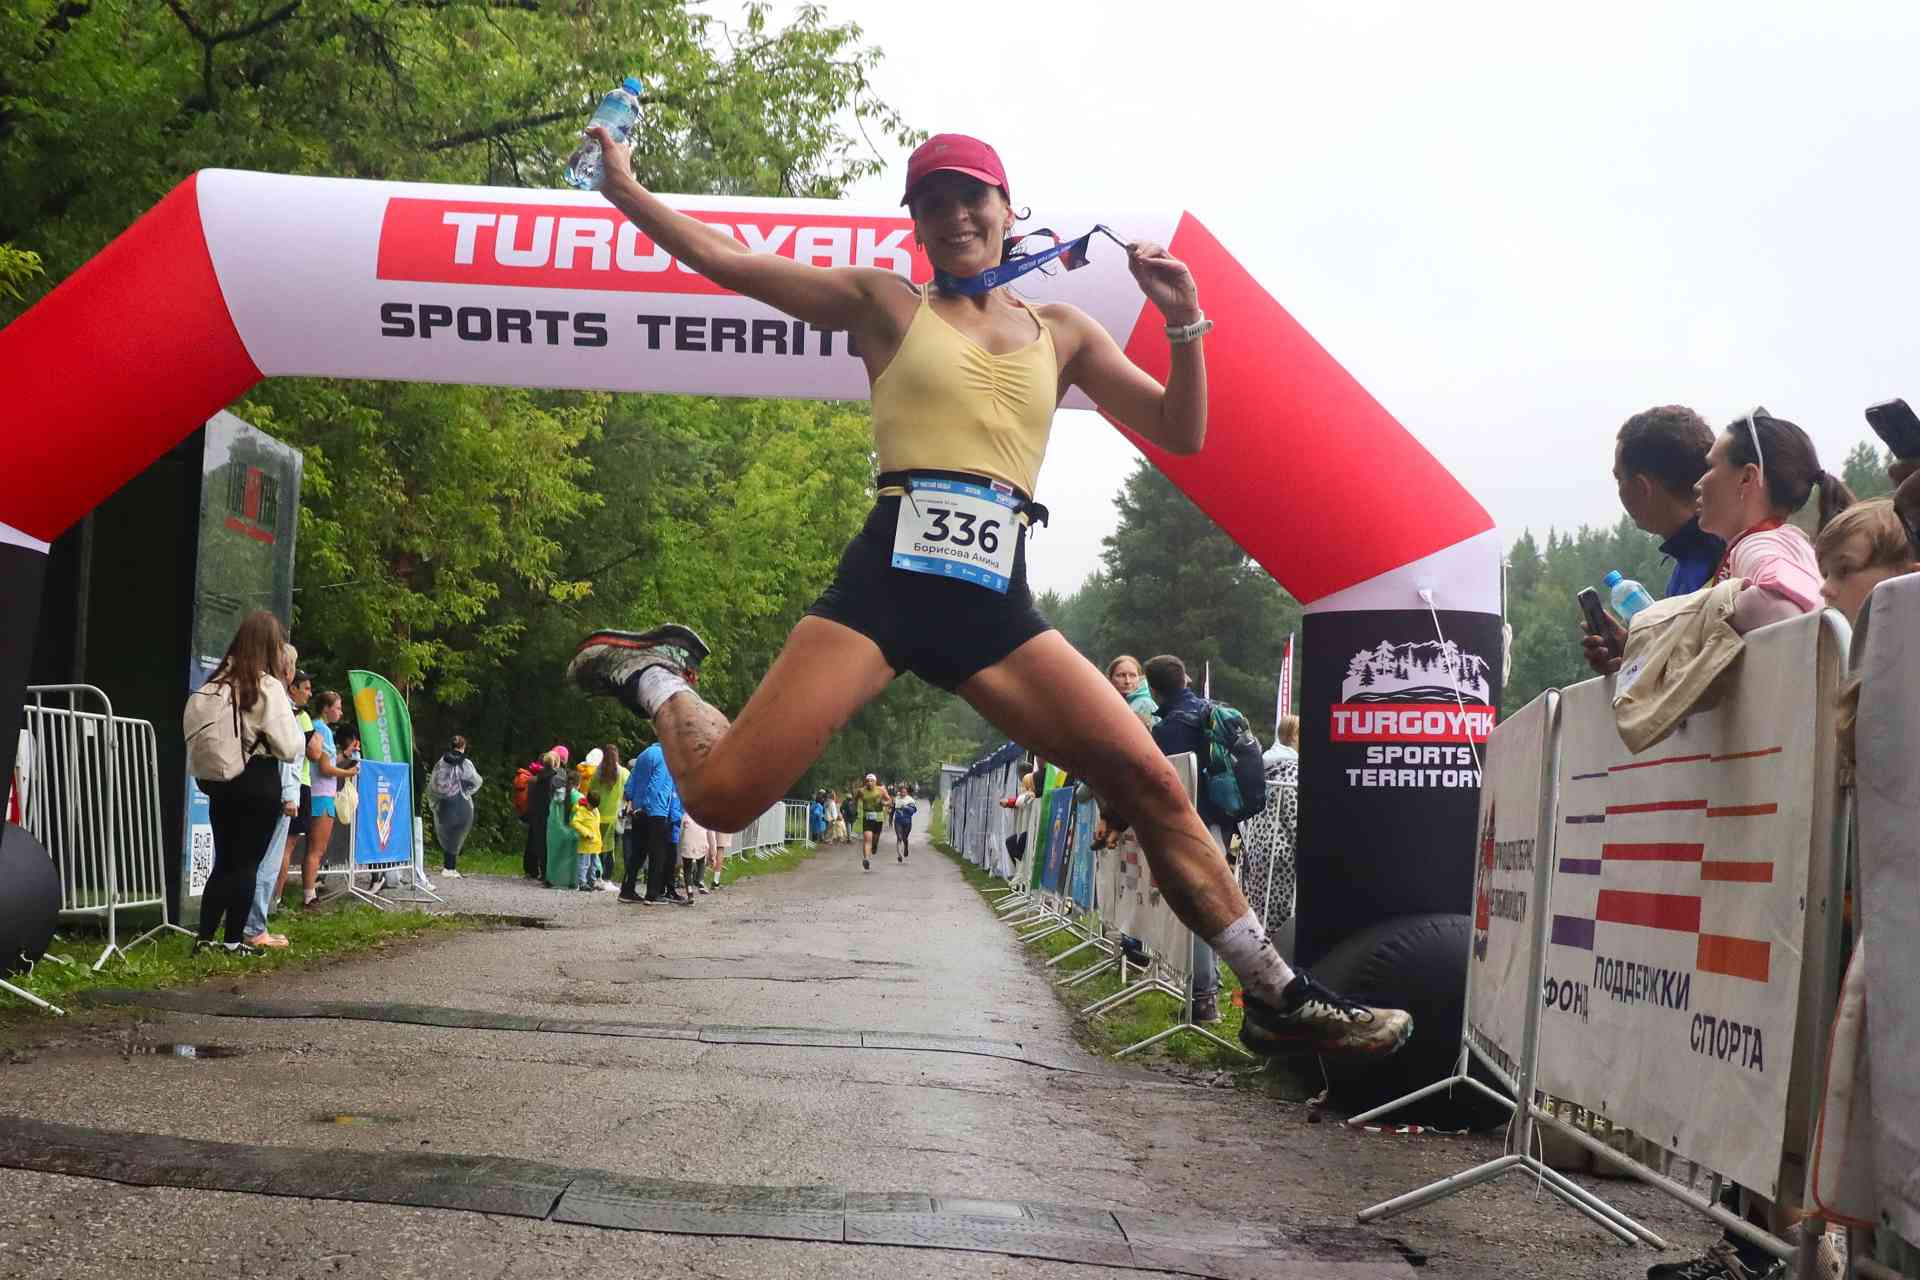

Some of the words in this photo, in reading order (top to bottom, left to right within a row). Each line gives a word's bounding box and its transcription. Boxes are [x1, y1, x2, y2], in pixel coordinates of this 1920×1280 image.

[380, 302, 608, 348] SPORTS
[923, 508, 1000, 553] 336
[913, 542, 970, 560] Борисова
[1333, 711, 1494, 735] TURGOYAK
[1367, 747, 1471, 765] SPORTS
[1544, 976, 1589, 1025] ФОНД
[1593, 956, 1691, 1011] ПОДДЕРЖКИ
[1690, 1013, 1763, 1072] СПОРТА
